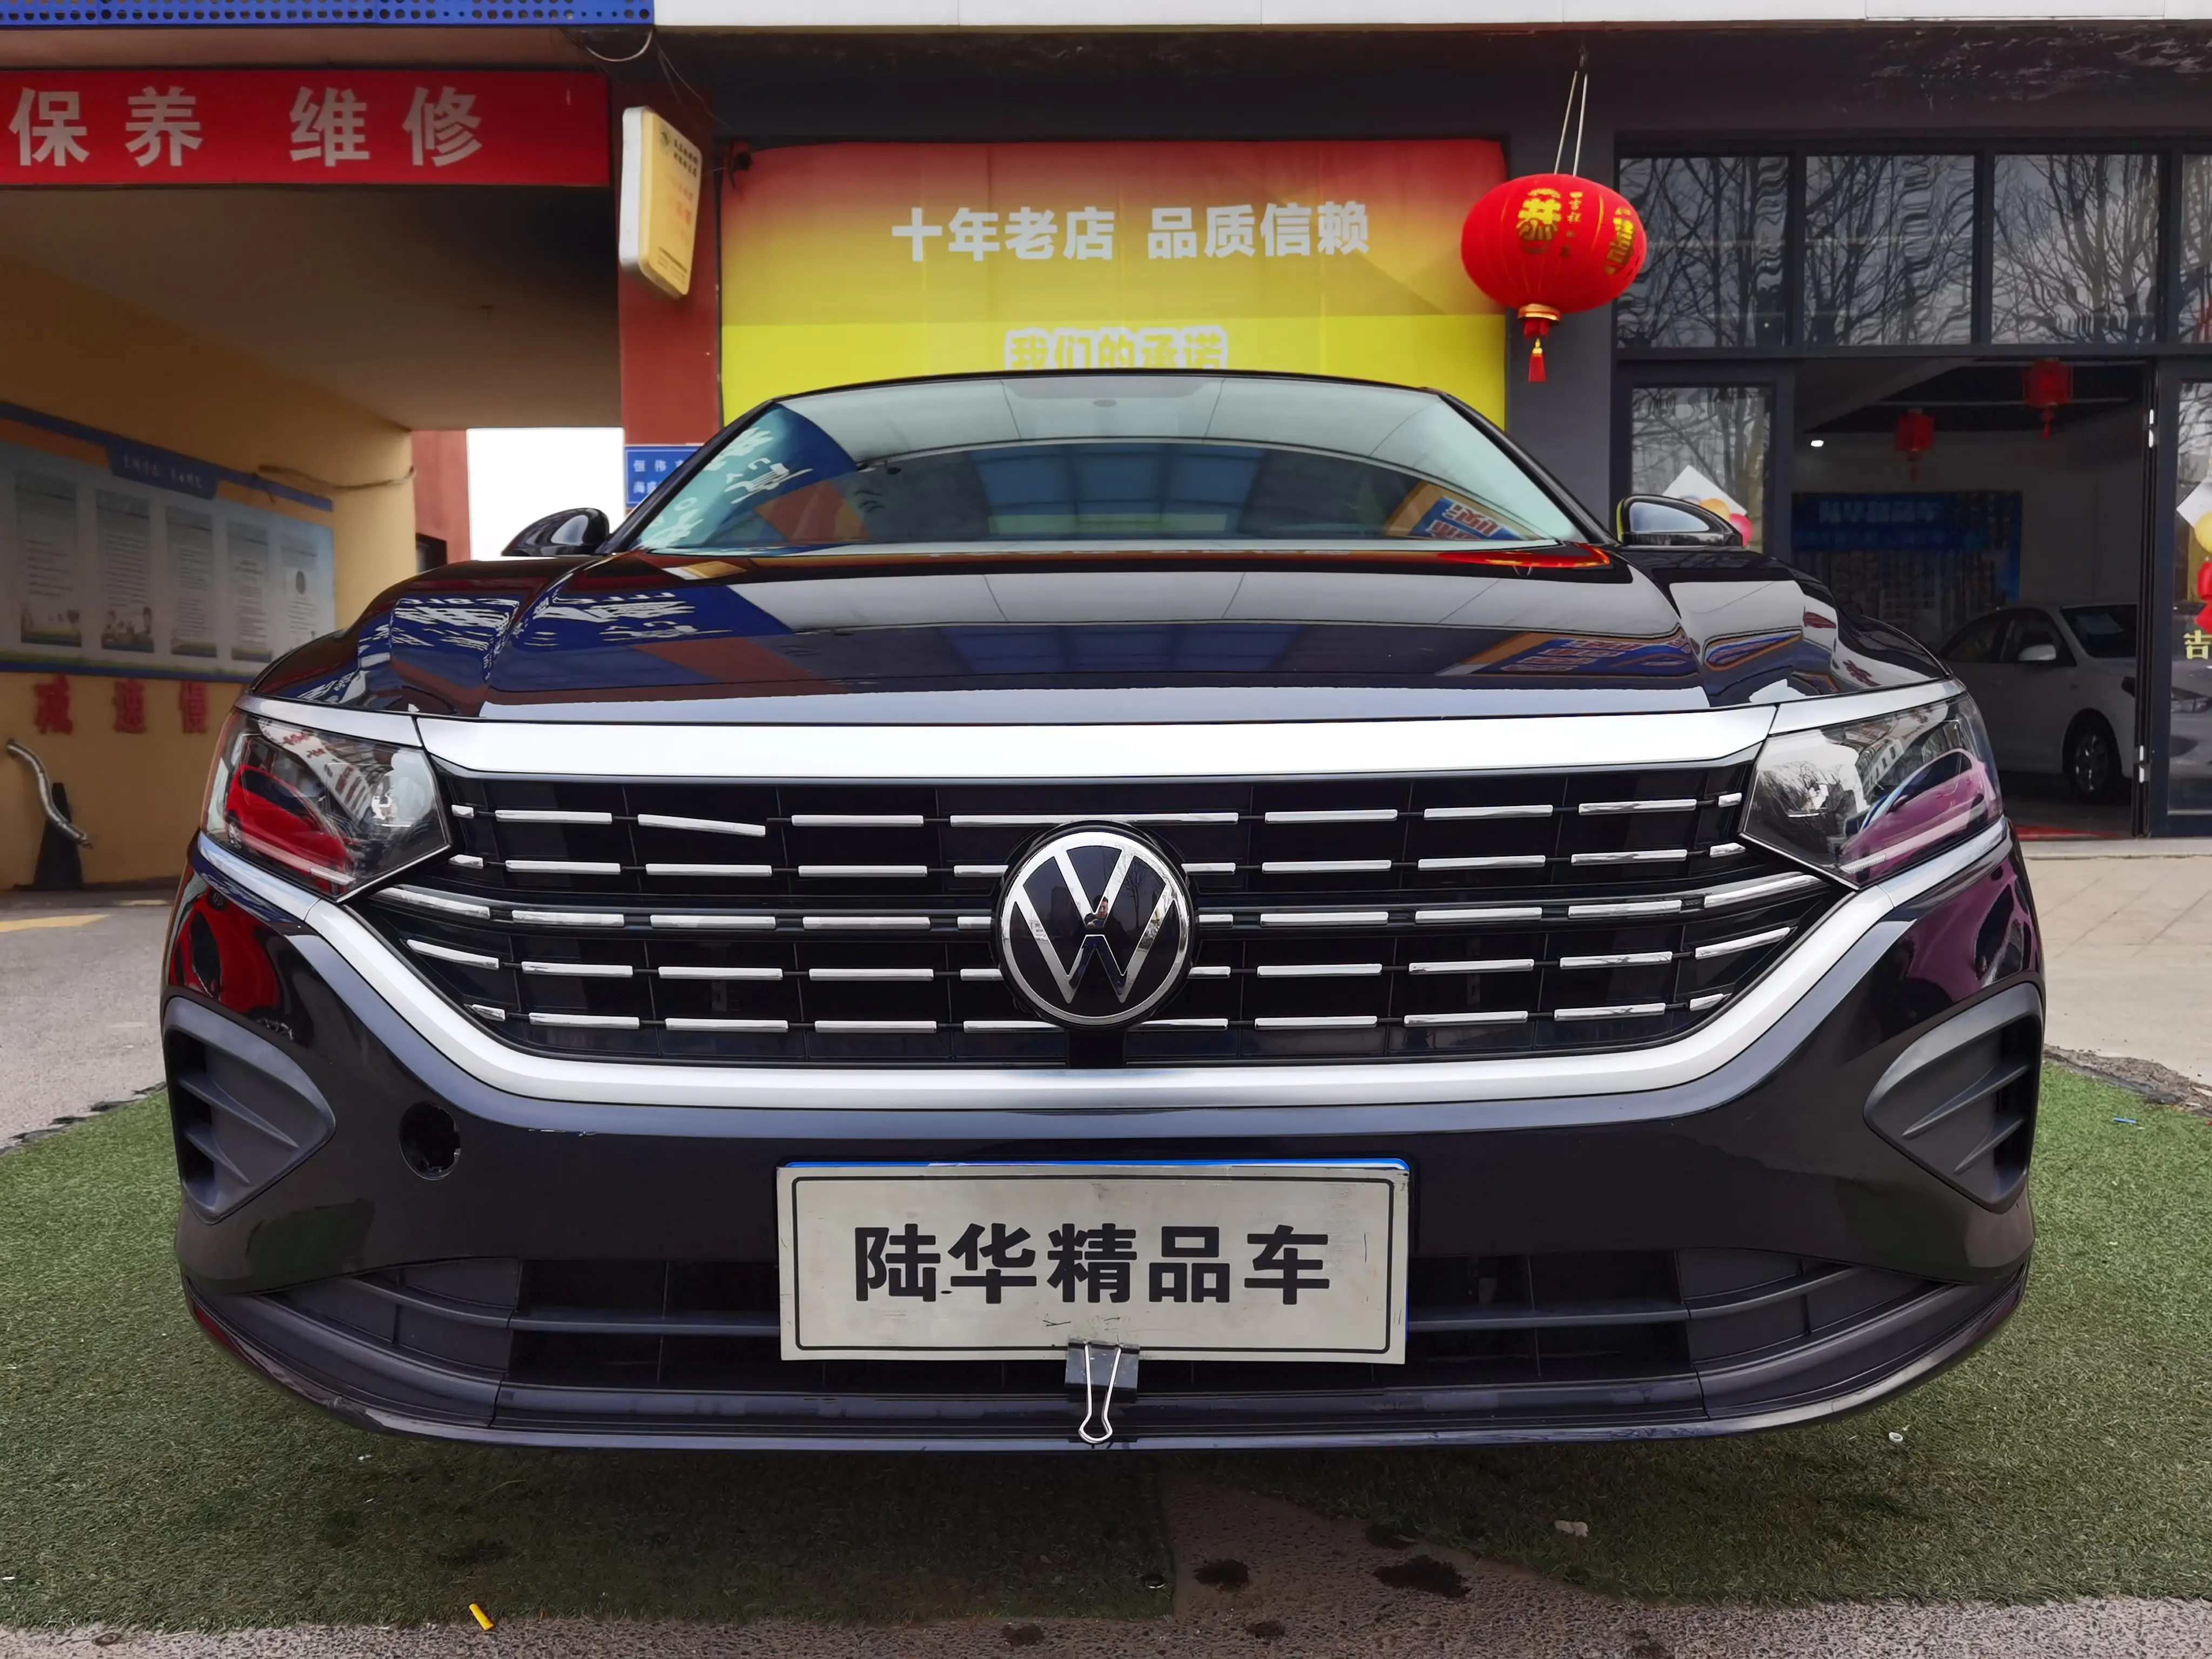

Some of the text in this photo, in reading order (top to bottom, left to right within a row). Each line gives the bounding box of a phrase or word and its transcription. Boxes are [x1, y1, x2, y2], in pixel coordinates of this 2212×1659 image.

[9, 86, 483, 167] 保养 维修
[892, 201, 1370, 262] 十年老店 品质信赖
[1006, 327, 1228, 369] 我们的承诺
[854, 1222, 1331, 1305] 陆华精品车
